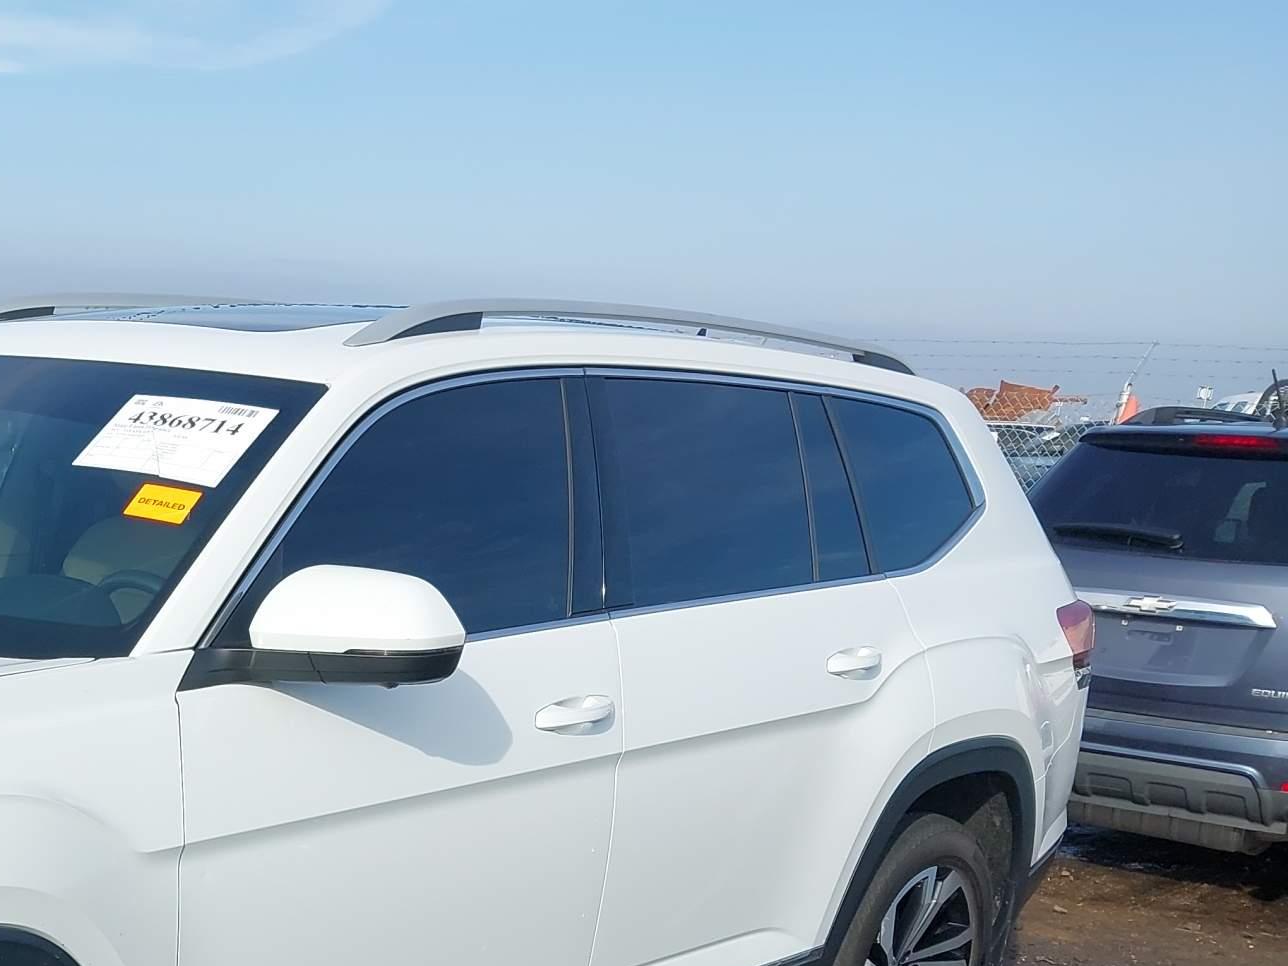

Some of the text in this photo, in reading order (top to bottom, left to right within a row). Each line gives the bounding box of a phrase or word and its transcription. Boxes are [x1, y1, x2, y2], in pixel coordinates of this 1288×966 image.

[129, 411, 245, 436] 43868714
[137, 496, 185, 511] DETAILED
[1251, 688, 1288, 699] EQUI
